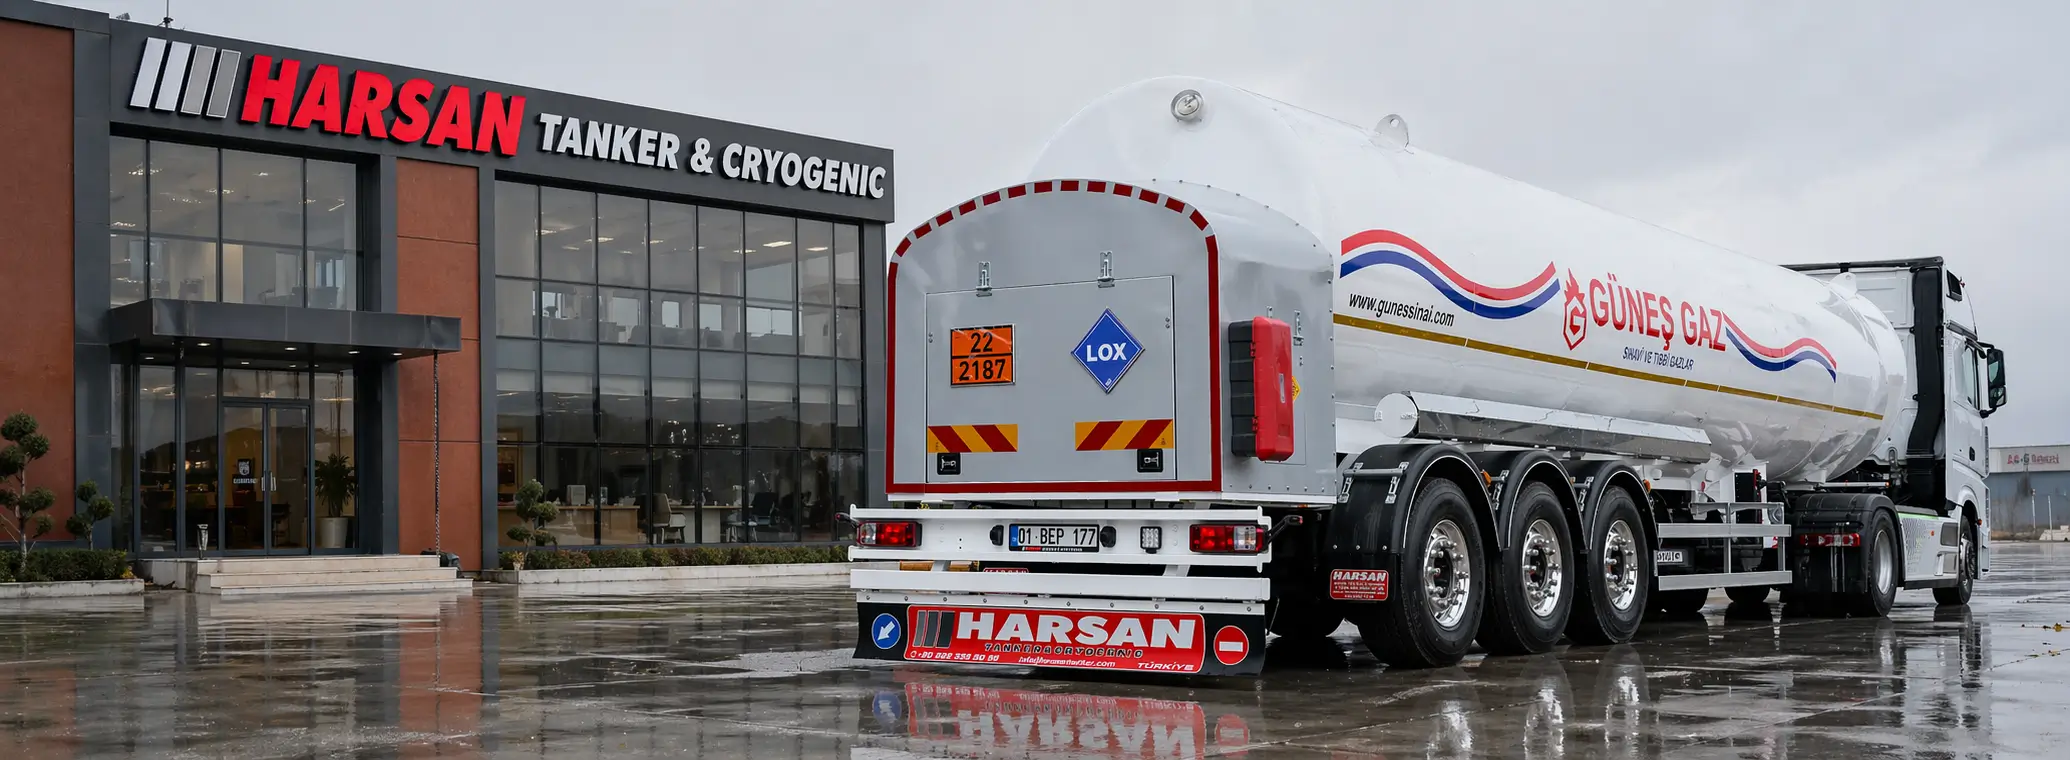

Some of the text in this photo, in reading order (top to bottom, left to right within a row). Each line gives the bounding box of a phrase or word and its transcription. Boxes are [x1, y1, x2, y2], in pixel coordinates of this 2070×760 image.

[241, 54, 526, 156] HARSAN
[539, 113, 886, 199] TANKER & CRYOGENIC
[1349, 293, 1455, 327] www.gunessinai.com
[1589, 272, 1727, 352] GÜNEŞ GAZ
[970, 332, 993, 353] 22
[1086, 342, 1127, 362] LOX
[959, 359, 1006, 382] 2187
[1018, 528, 1096, 545] 01 BEP 177
[1333, 571, 1387, 582] HARSAN
[956, 611, 1196, 649] HARSAN
[1137, 661, 1194, 671] TÜRKİYE
